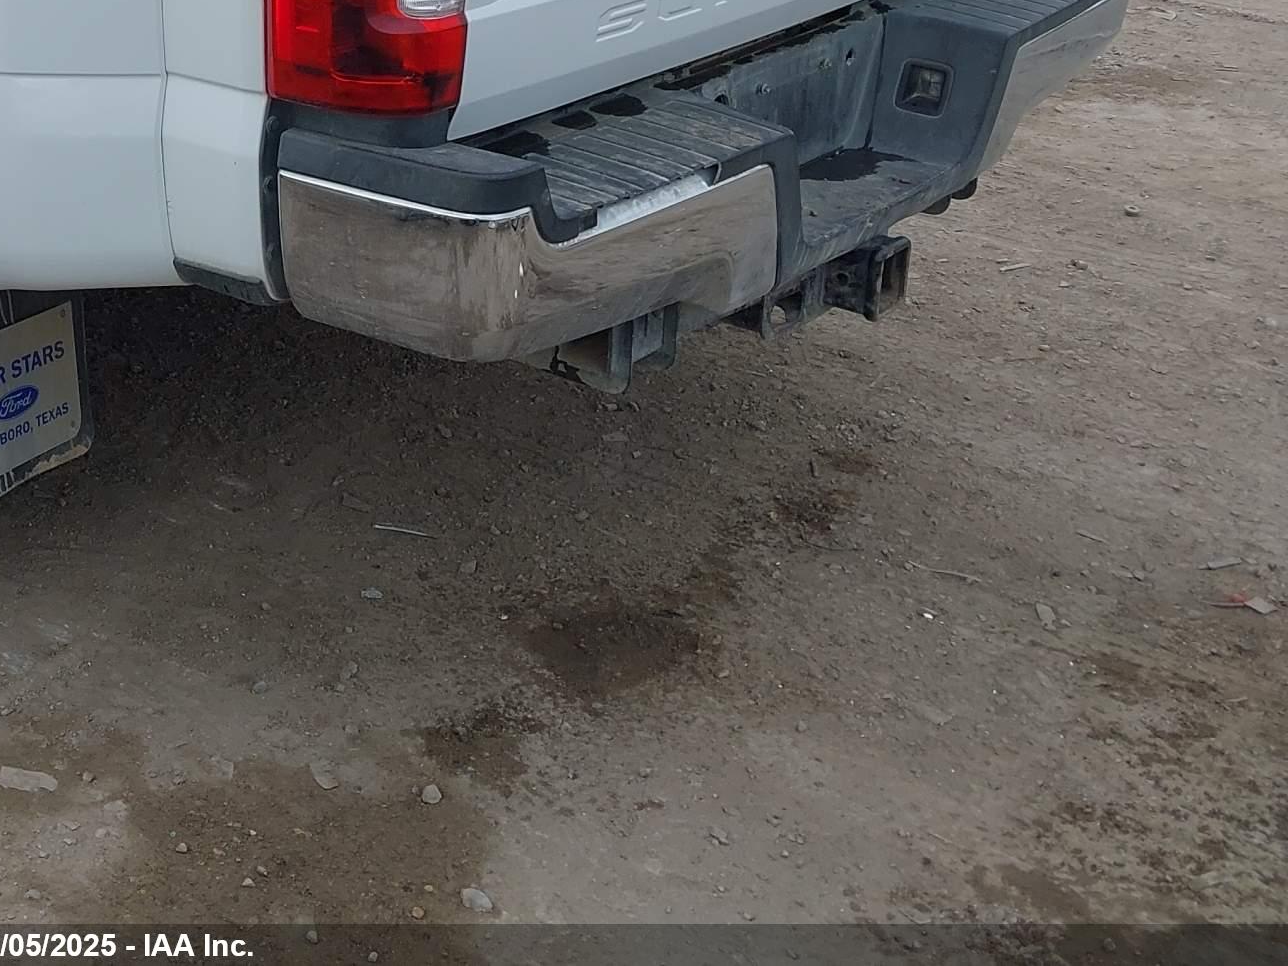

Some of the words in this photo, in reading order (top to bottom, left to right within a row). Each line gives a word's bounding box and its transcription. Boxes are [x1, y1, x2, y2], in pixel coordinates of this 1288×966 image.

[10, 339, 65, 379] STARS
[0, 390, 33, 418] Ford
[35, 401, 70, 428] TEXAS
